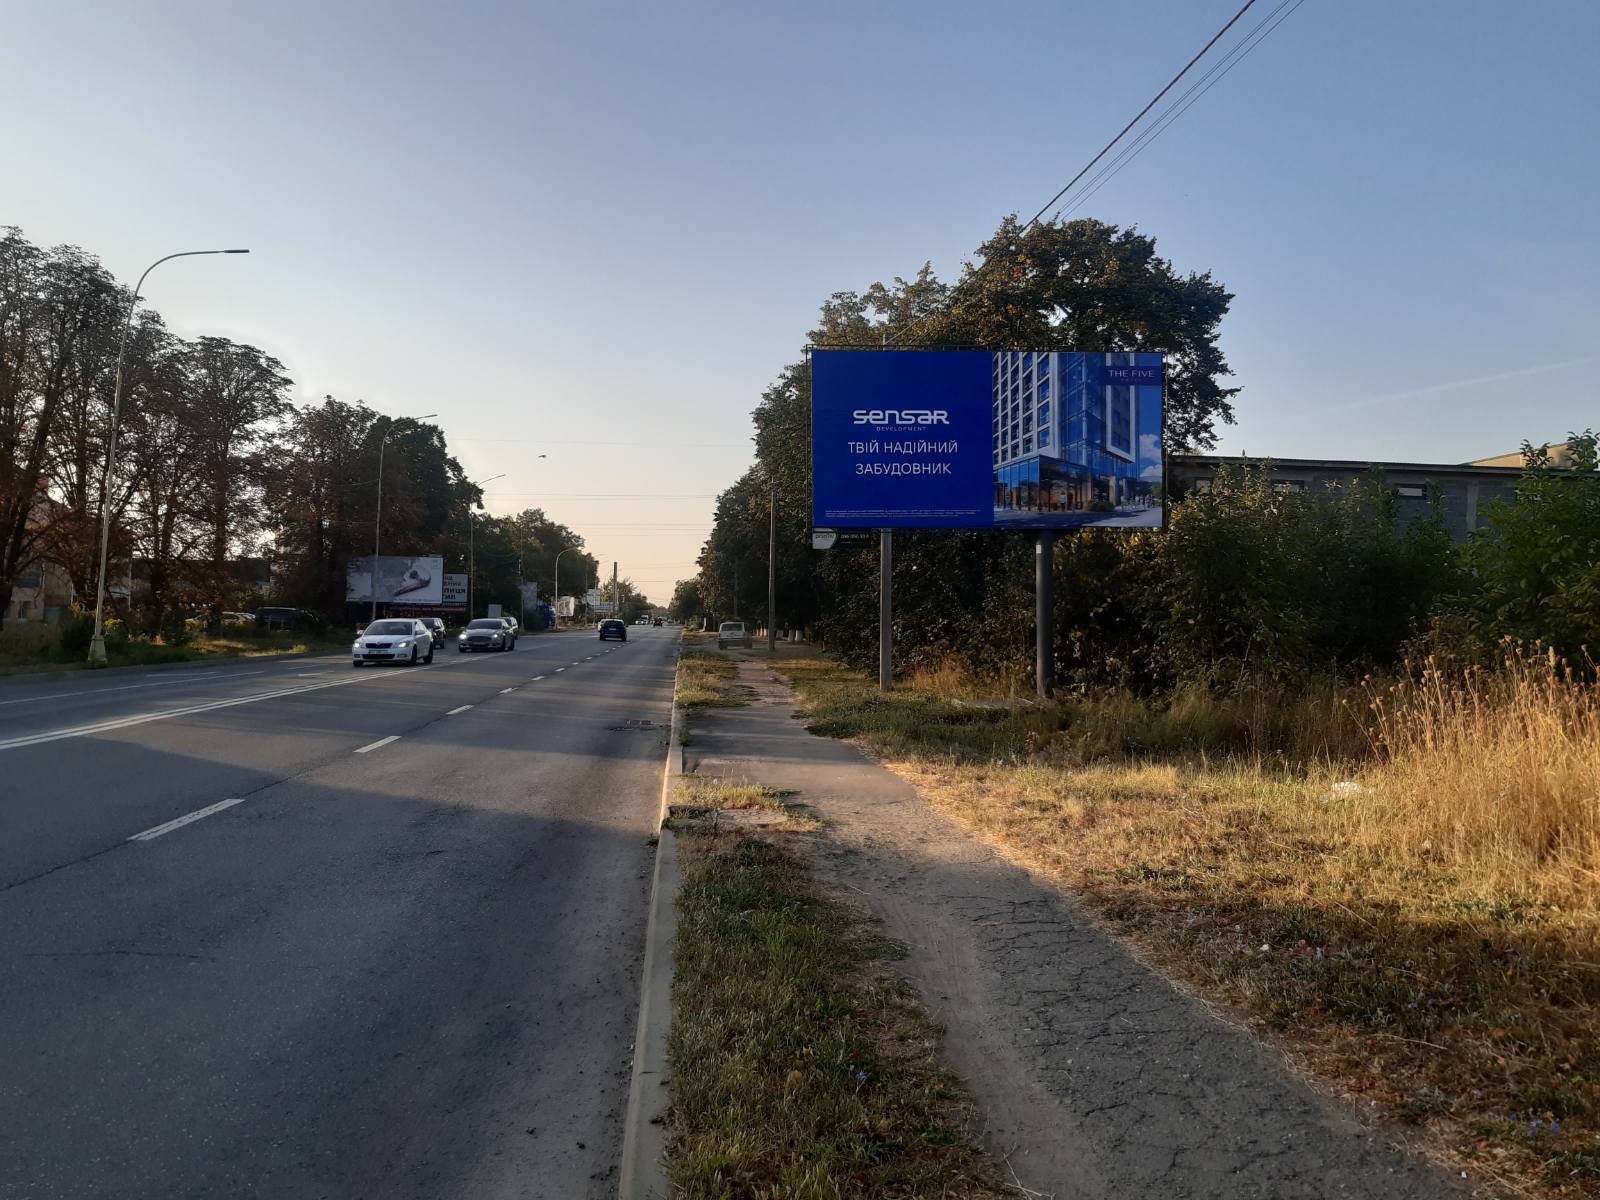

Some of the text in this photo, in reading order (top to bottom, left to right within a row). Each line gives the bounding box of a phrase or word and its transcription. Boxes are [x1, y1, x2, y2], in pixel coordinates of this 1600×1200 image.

[1108, 369, 1155, 378] THE FIVE
[848, 440, 958, 455] ТВІЙ НАДІЙНИЙ
[855, 463, 952, 476] ЗАБУДОВНИК
